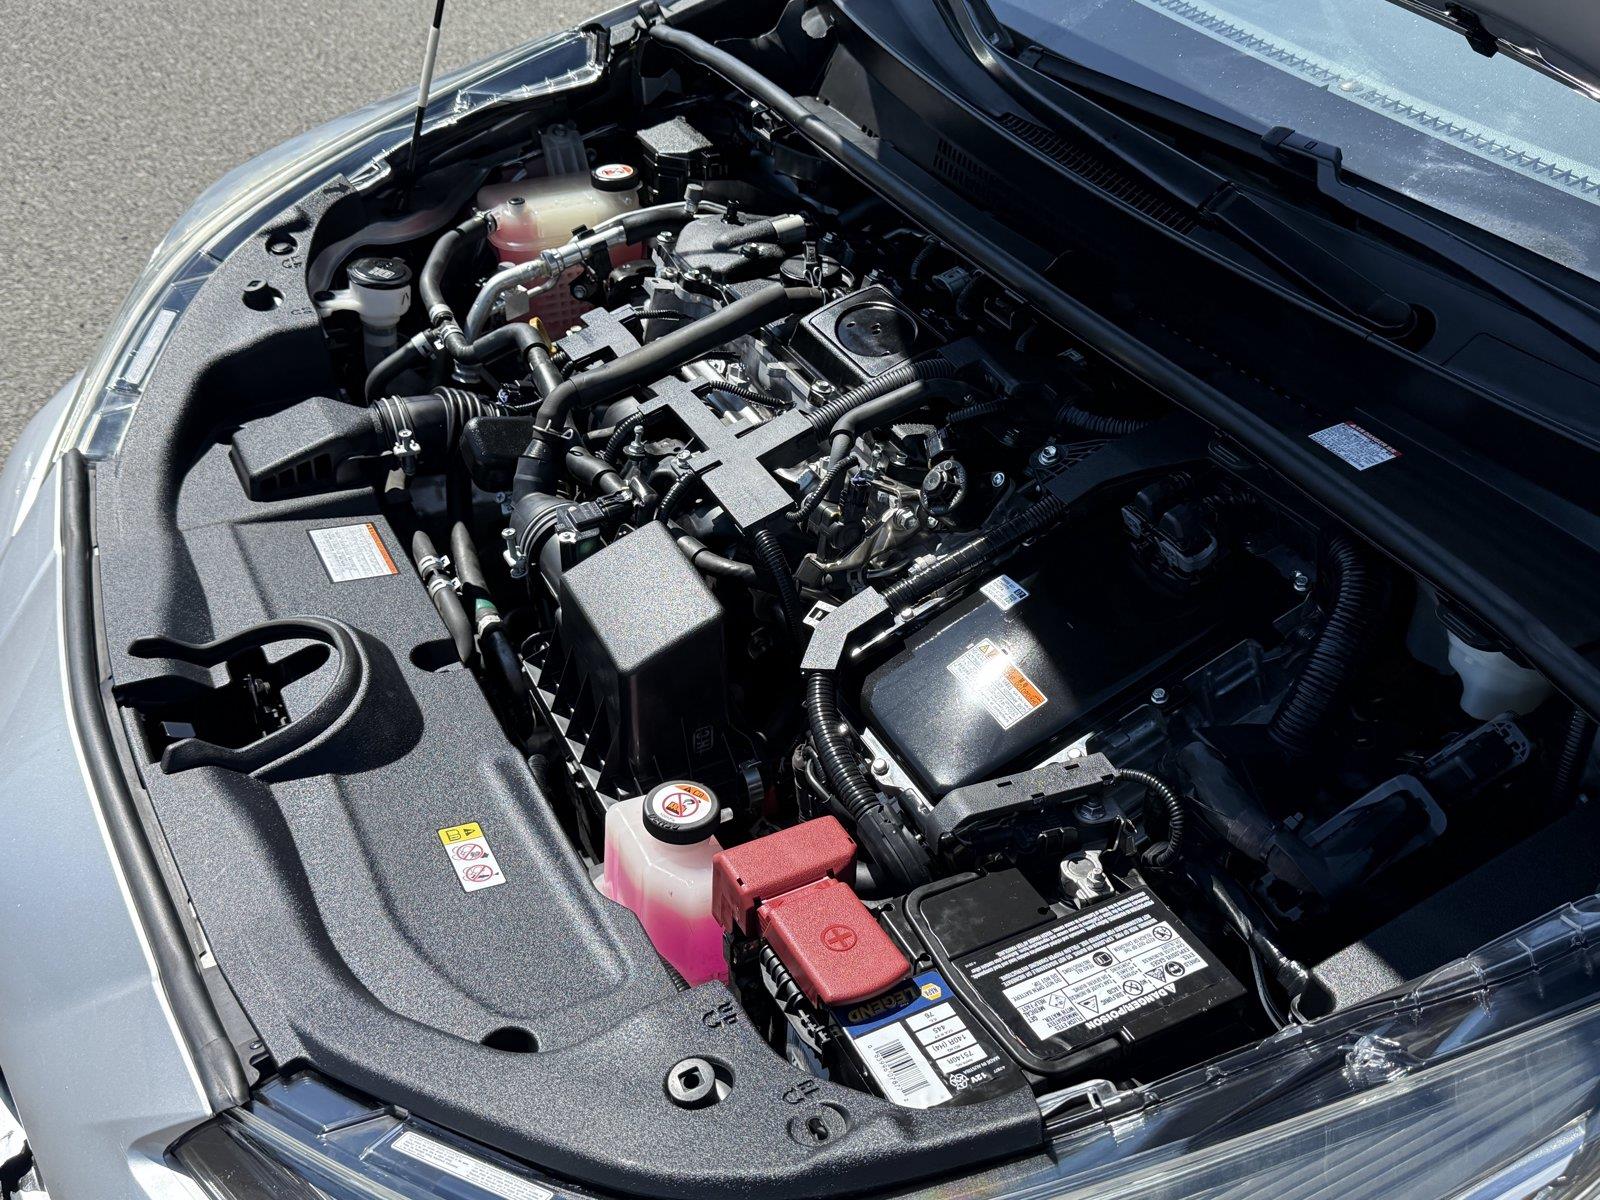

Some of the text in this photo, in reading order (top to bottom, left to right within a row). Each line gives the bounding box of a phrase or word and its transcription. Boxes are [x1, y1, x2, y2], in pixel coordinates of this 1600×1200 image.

[924, 986, 938, 996] NAPA
[848, 987, 917, 1023] LEGEND
[1033, 998, 1046, 1006] HELP
[1022, 1004, 1045, 1017] MEDICAL
[1041, 1005, 1074, 1022] WITH WATER.
[1084, 987, 1168, 1029] DANGER/POISON
[1027, 1015, 1038, 1023] GET
[1046, 1011, 1078, 1027] IMMEDIATELY
[1054, 1015, 1082, 1031] FLUSH EYES
[932, 1024, 945, 1033] 445
[947, 1034, 966, 1045] 140R
[931, 1040, 947, 1051] (H4)
[946, 1050, 973, 1064] 75140R
[985, 1055, 1000, 1064] MADE
[962, 1063, 981, 1074] AUSTRIA
[969, 1071, 987, 1083] 12V
